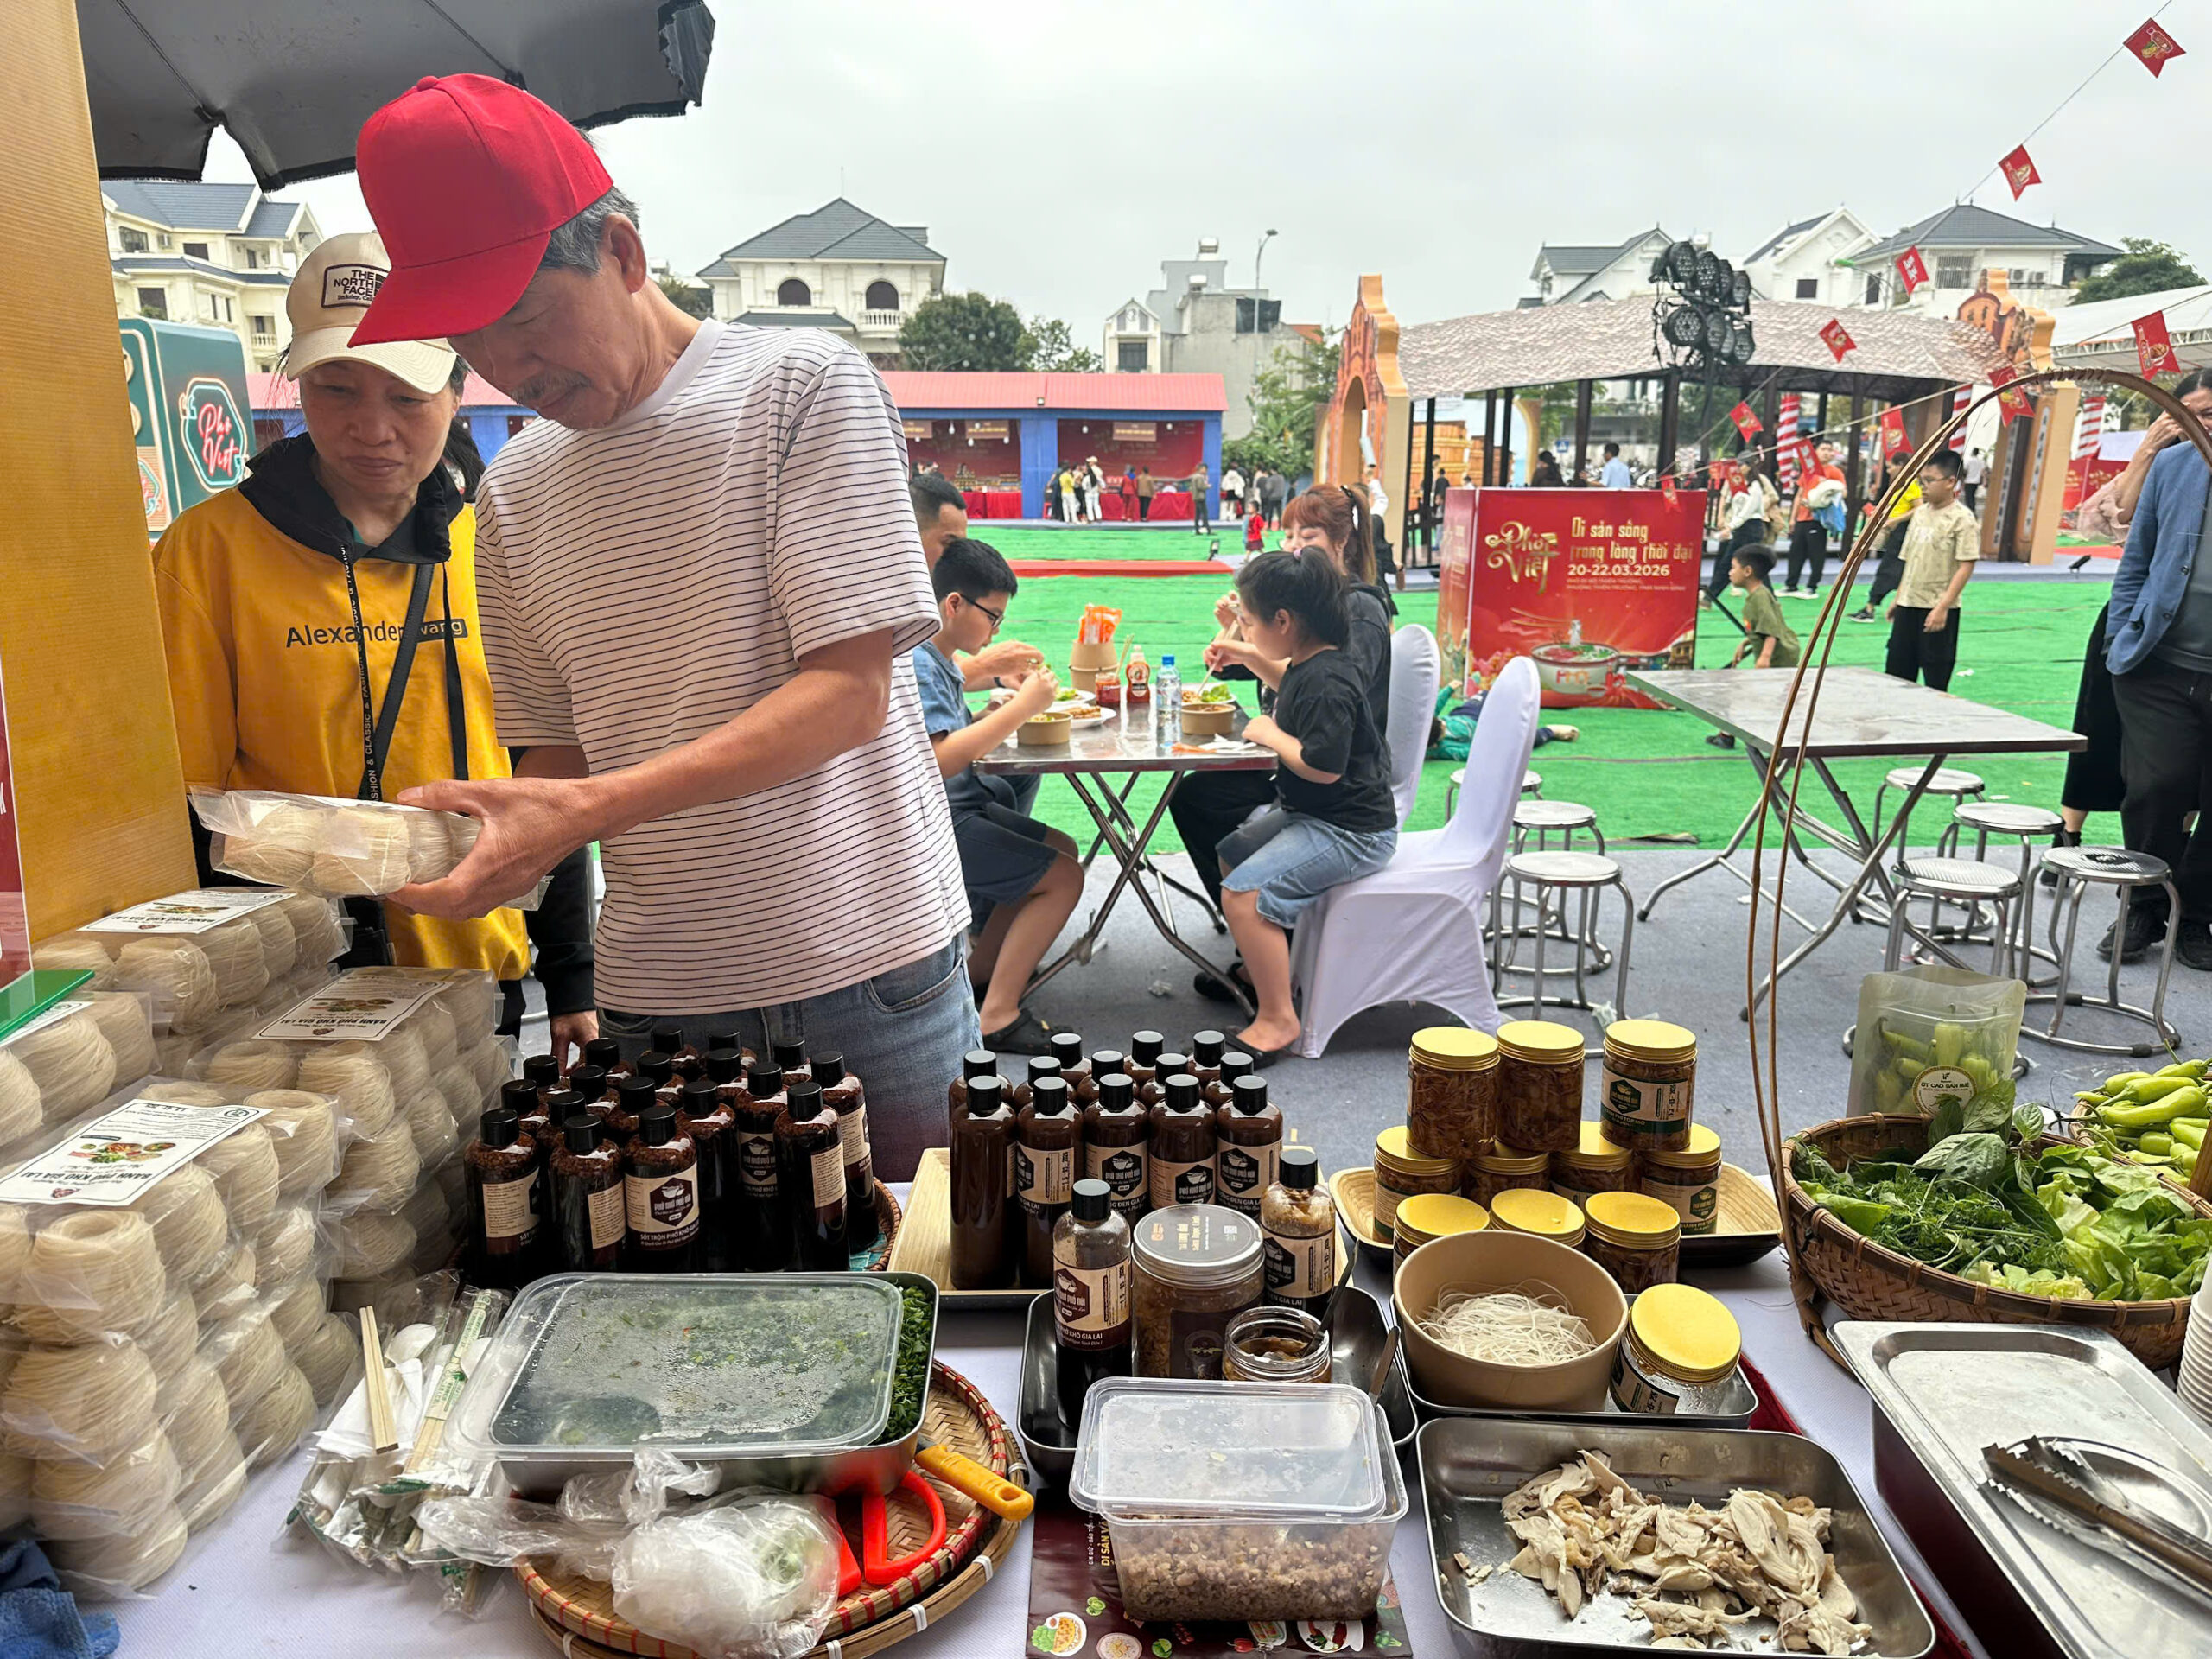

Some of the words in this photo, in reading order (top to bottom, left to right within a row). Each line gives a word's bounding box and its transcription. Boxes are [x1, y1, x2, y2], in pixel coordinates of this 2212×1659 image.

[351, 270, 375, 281] THE
[334, 277, 374, 289] NORTH
[343, 285, 373, 296] FACE
[1590, 519, 1614, 538] sản
[1618, 518, 1649, 544] sống
[1610, 540, 1637, 566] lòng
[1567, 563, 1671, 577] 20-22.03.2026
[1097, 1535, 1110, 1554] SẢN
